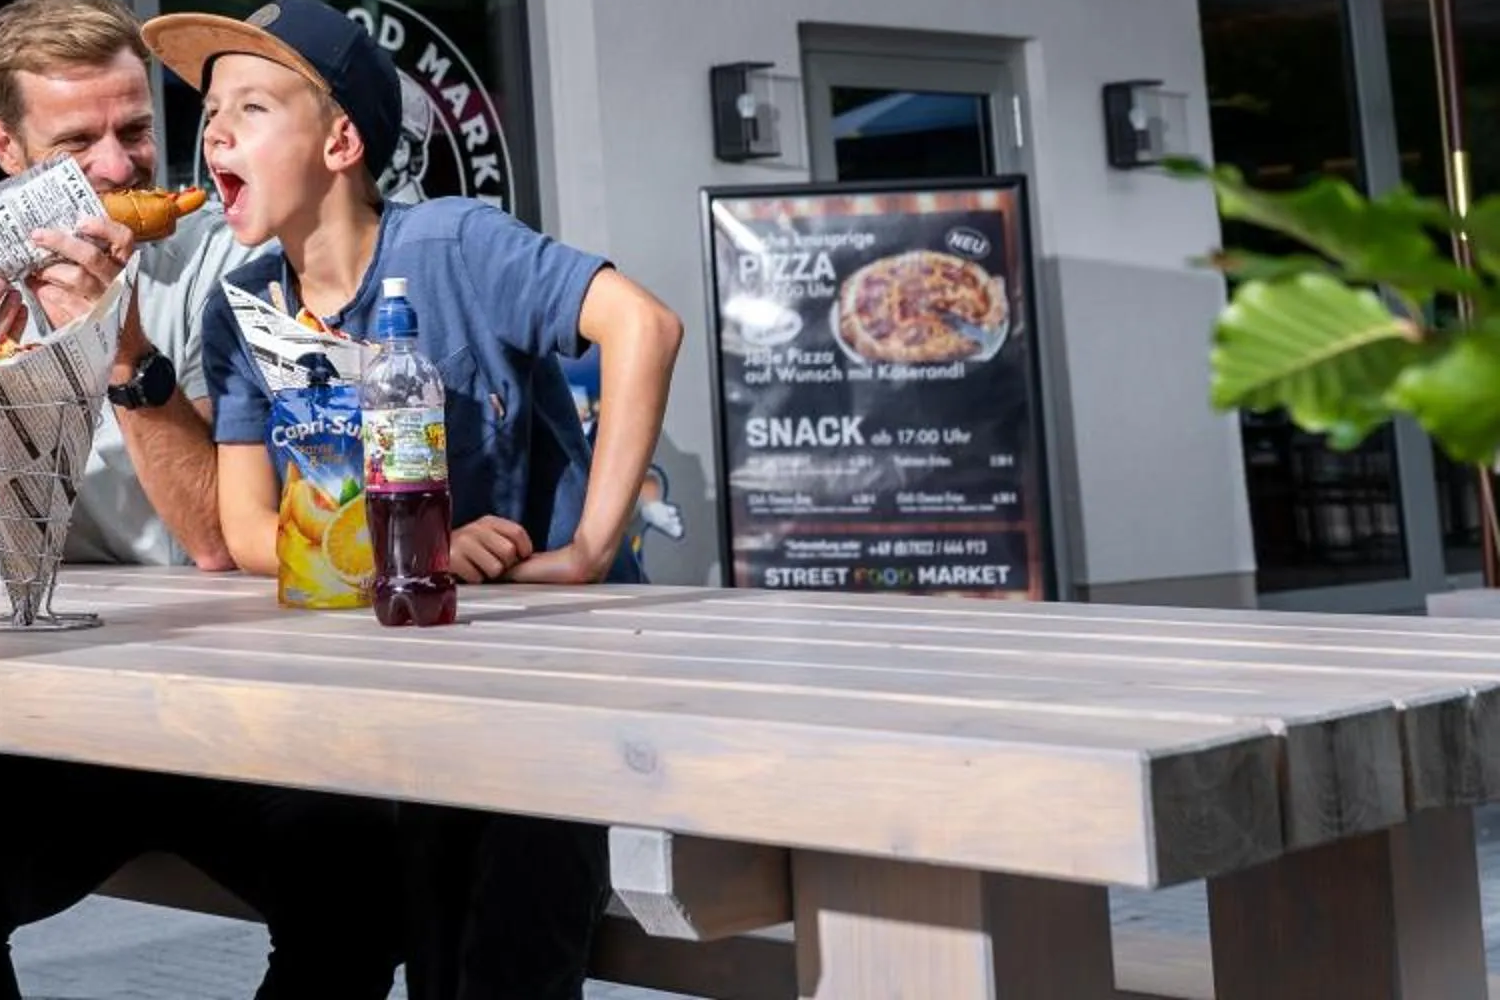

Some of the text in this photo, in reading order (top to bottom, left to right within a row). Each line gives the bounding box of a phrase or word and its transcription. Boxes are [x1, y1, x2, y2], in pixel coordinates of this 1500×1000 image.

[417, 43, 501, 207] MARK
[947, 231, 987, 254] NEU
[739, 252, 837, 282] PIZZA
[788, 348, 834, 365] Pizza
[745, 368, 772, 384] auf
[776, 365, 842, 382] Wunsch
[746, 416, 972, 448] SNACK ab 17:00 Uhr
[764, 567, 849, 587] STREET
[918, 565, 1011, 585] MARKET
